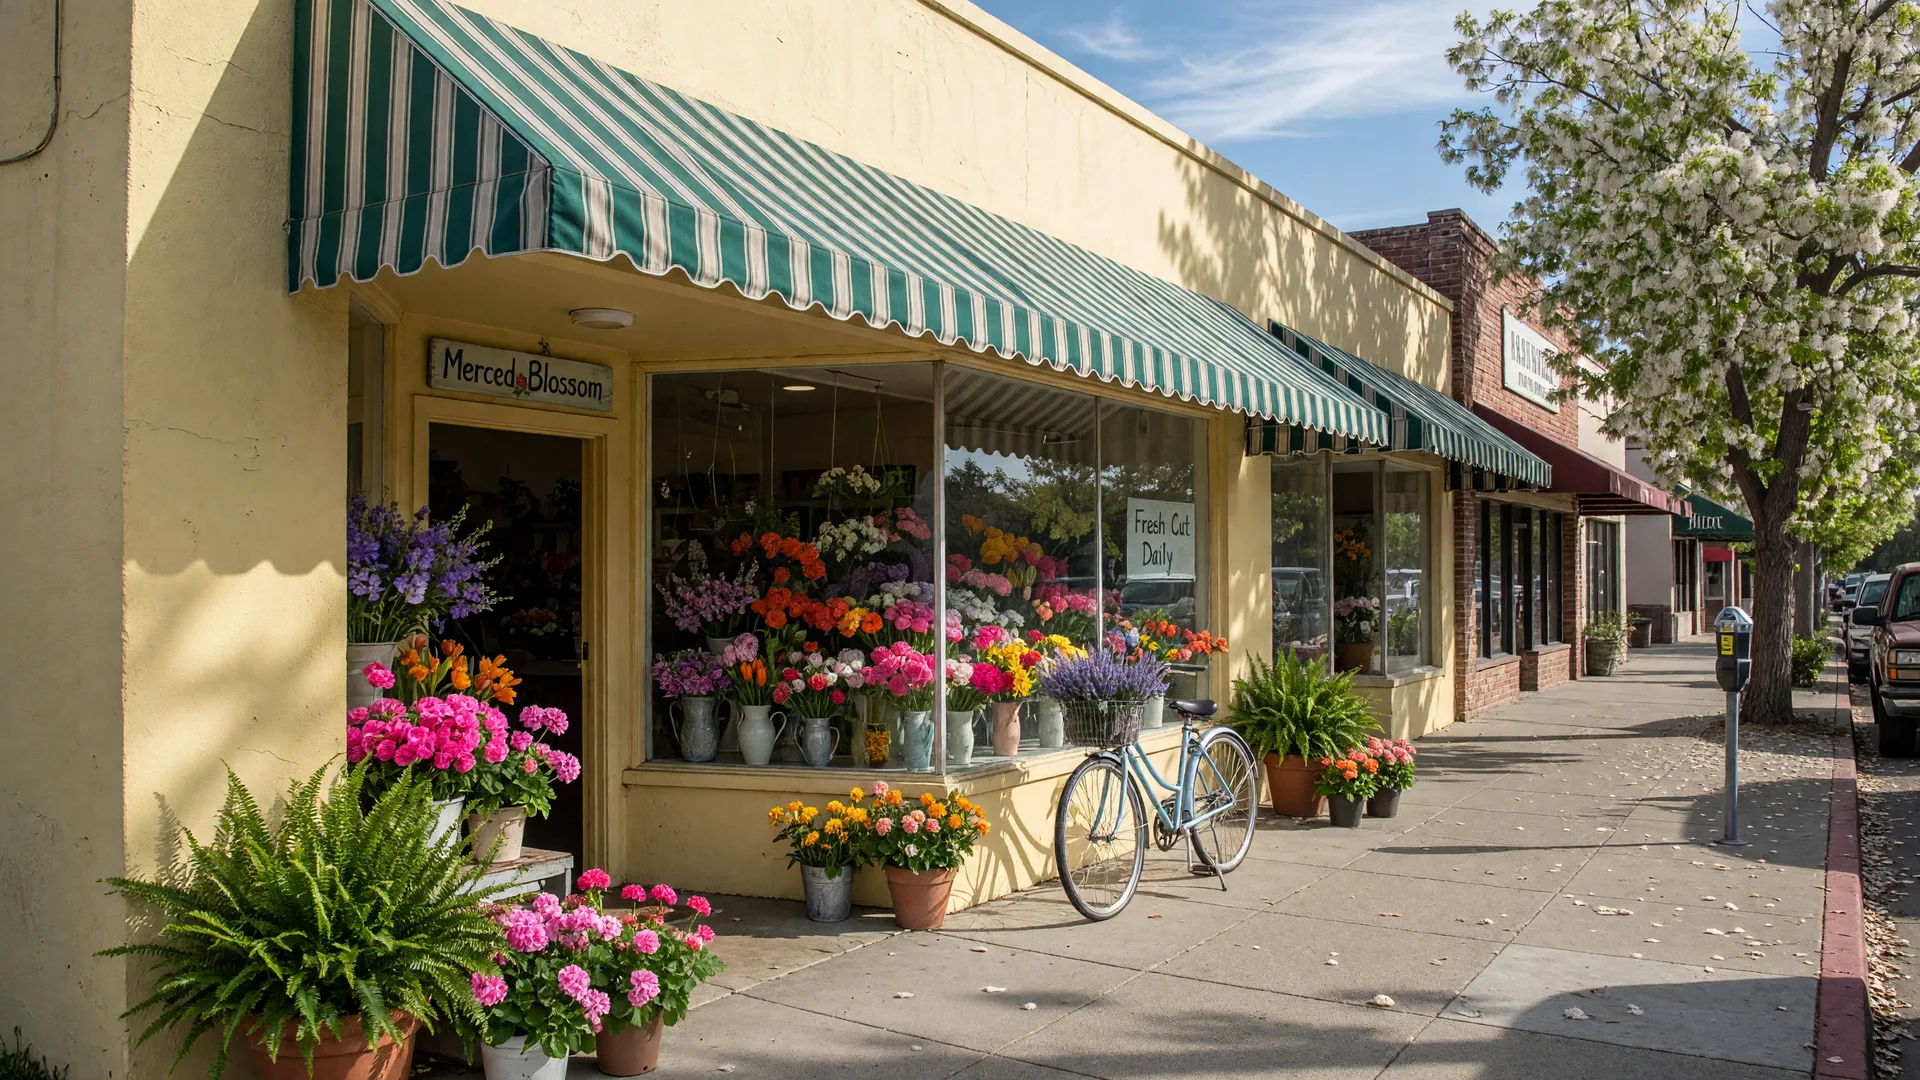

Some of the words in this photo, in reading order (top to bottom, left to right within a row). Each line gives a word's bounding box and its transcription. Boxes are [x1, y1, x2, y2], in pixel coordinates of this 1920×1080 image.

[443, 347, 515, 387] Merced
[528, 359, 602, 400] Blossom
[1135, 509, 1165, 535] Fresh
[1171, 512, 1190, 536] Cut
[1142, 541, 1173, 575] Daily
